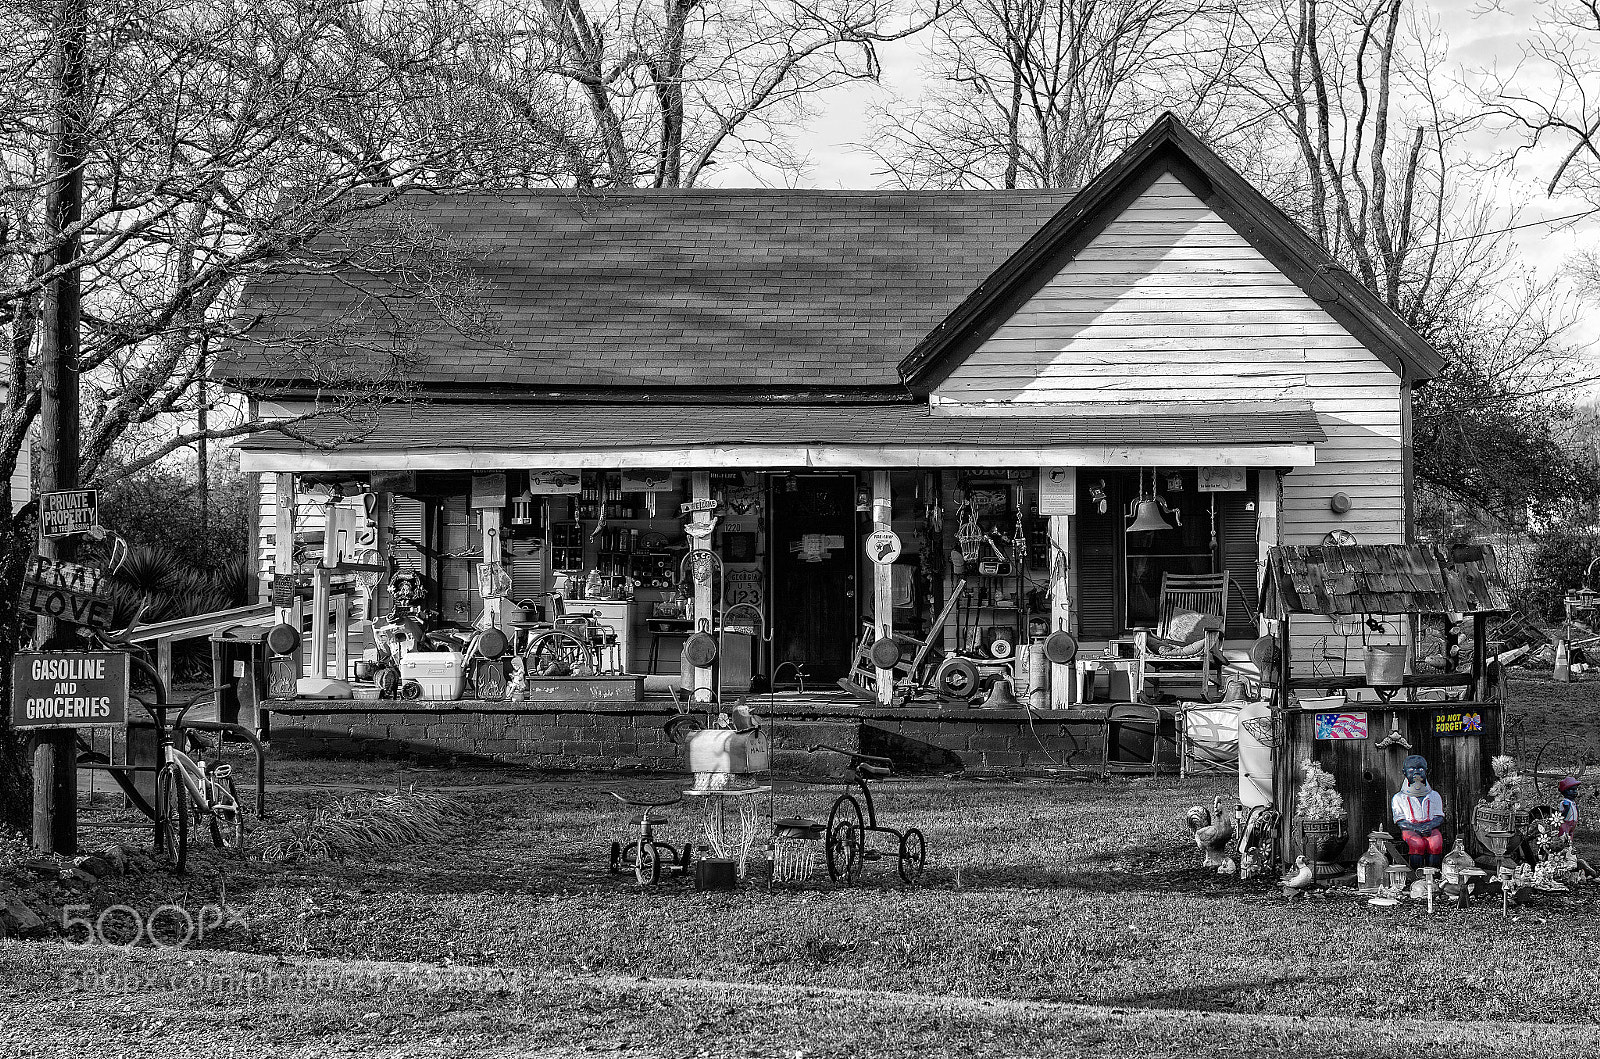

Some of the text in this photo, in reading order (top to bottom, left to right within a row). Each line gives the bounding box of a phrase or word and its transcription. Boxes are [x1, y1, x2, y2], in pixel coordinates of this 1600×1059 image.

[49, 492, 89, 510] PRIVATE
[44, 507, 95, 526] PROPERTY
[34, 555, 105, 595] PRAY
[731, 573, 758, 581] GEORGIA
[733, 589, 760, 605] 123
[29, 586, 109, 628] LOVE
[32, 658, 106, 681] GASOLINE
[54, 682, 77, 695] AND
[26, 696, 110, 719] GROCERIES
[1436, 713, 1462, 723] DO NOT
[1435, 721, 1463, 733] FORGET
[751, 746, 765, 754] MAIL
